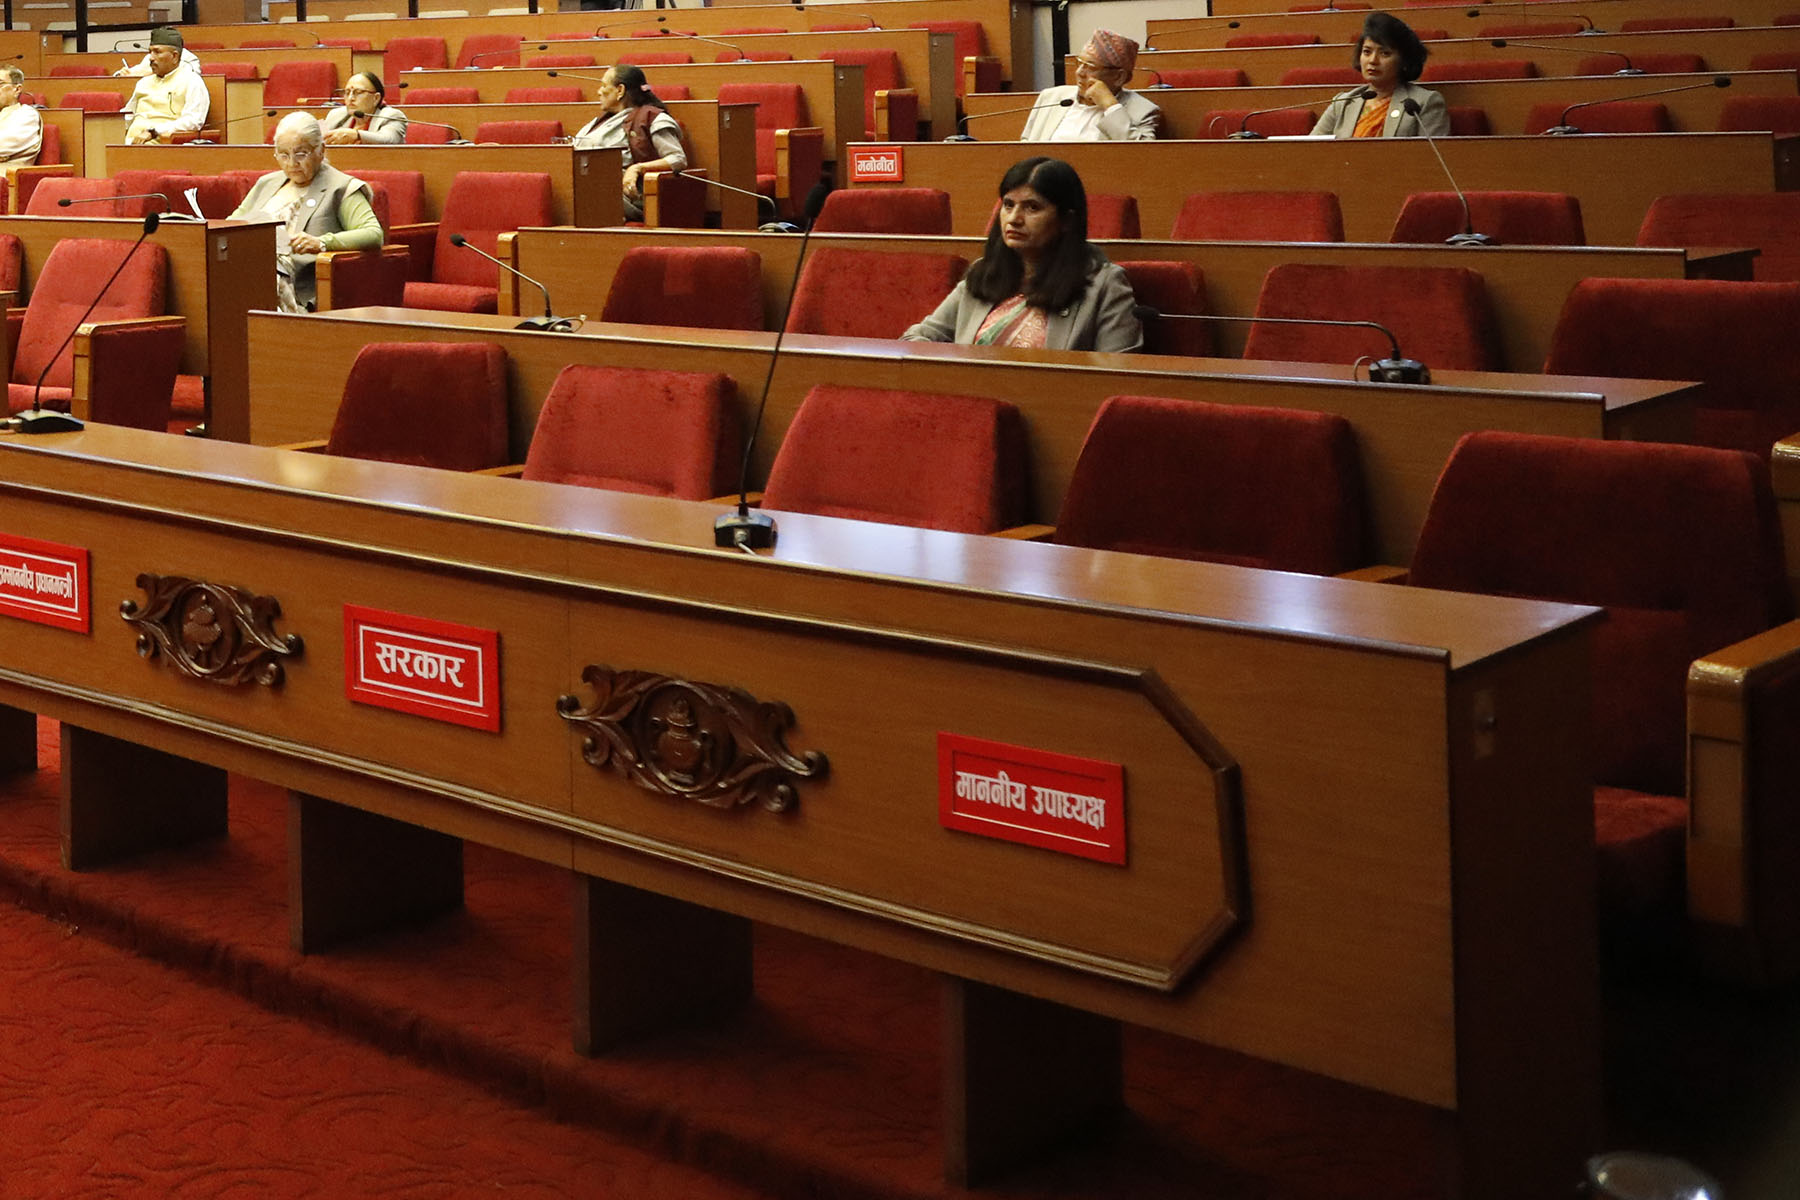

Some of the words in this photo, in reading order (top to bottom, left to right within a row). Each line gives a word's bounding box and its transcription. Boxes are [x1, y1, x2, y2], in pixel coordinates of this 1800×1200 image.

[857, 156, 894, 173] मनोनीत
[375, 642, 466, 688] सरकार
[955, 770, 1027, 811] माननीय
[1031, 785, 1106, 830] उपाध्यक्ष
